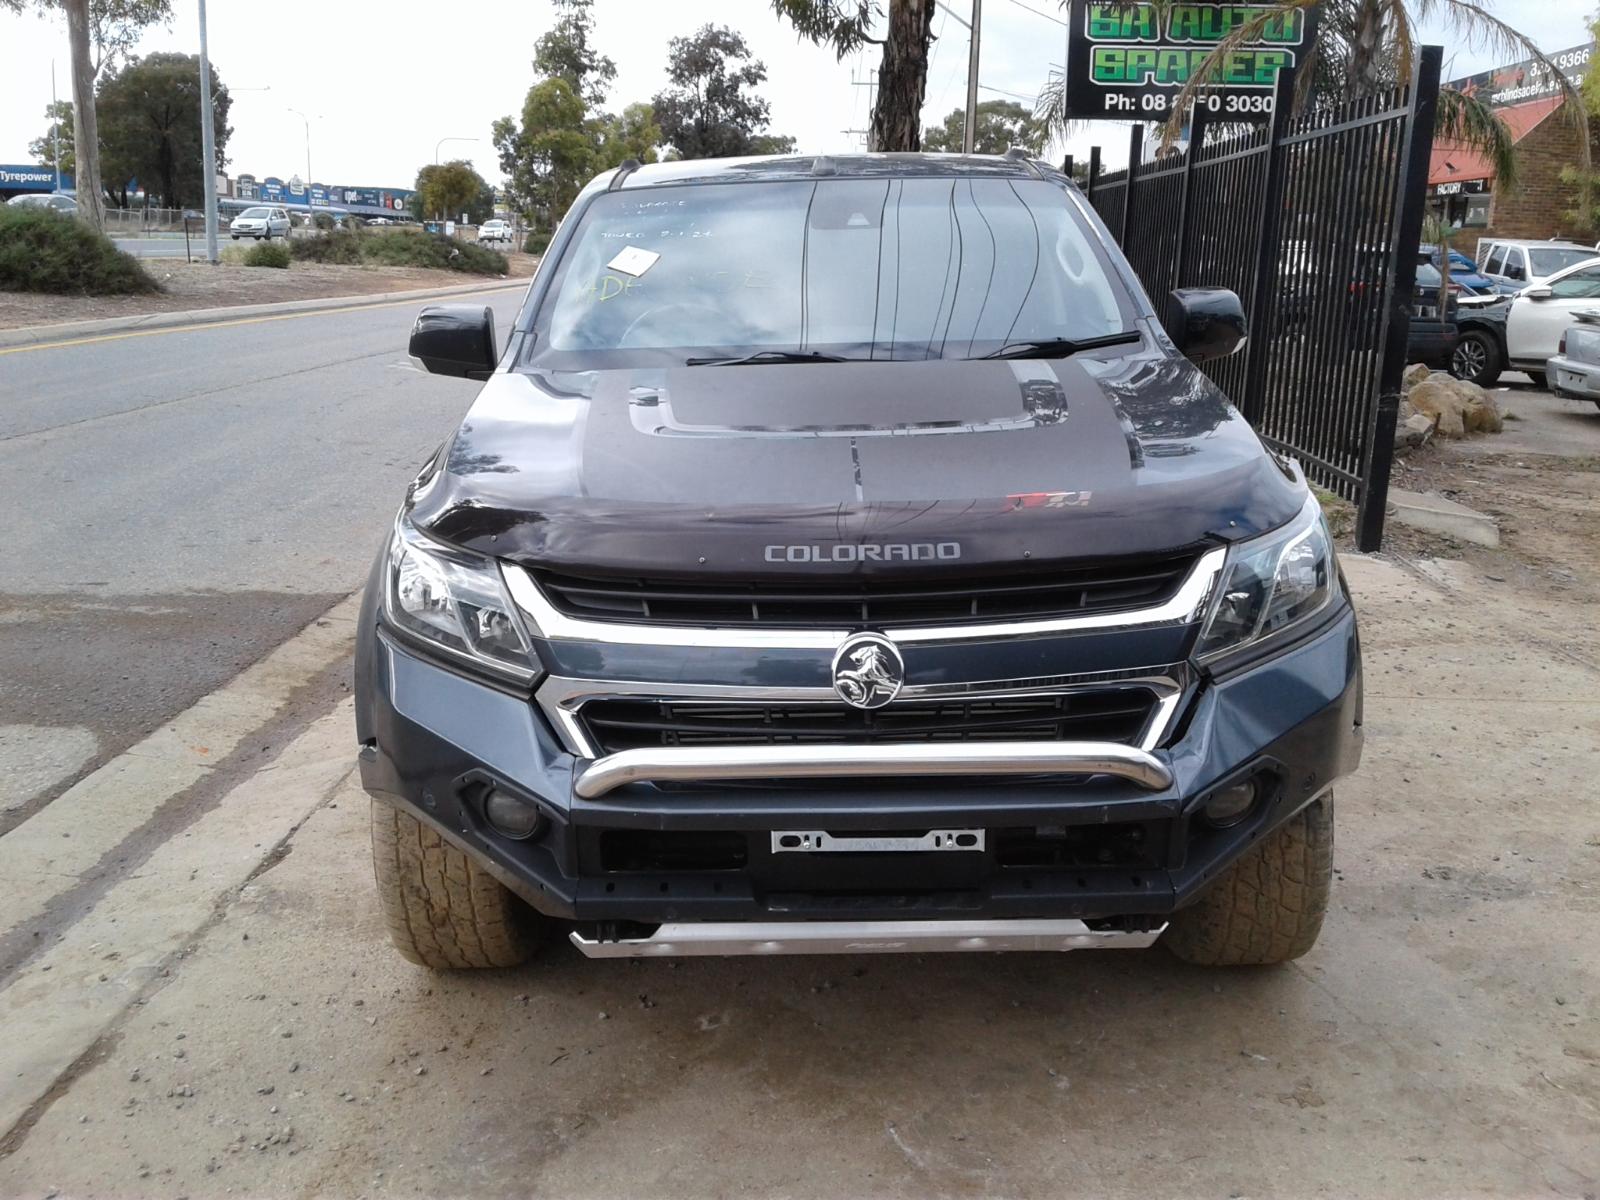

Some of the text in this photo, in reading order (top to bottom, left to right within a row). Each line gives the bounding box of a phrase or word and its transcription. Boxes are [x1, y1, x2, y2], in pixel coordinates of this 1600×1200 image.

[1090, 5, 1152, 37] SA
[1105, 94, 1136, 110] Ph:
[1142, 95, 1166, 110] 08
[1226, 96, 1275, 112] 3030
[0, 171, 53, 183] Tyrepower
[1437, 182, 1461, 195] FACTORY
[764, 542, 962, 563] COLORADO
